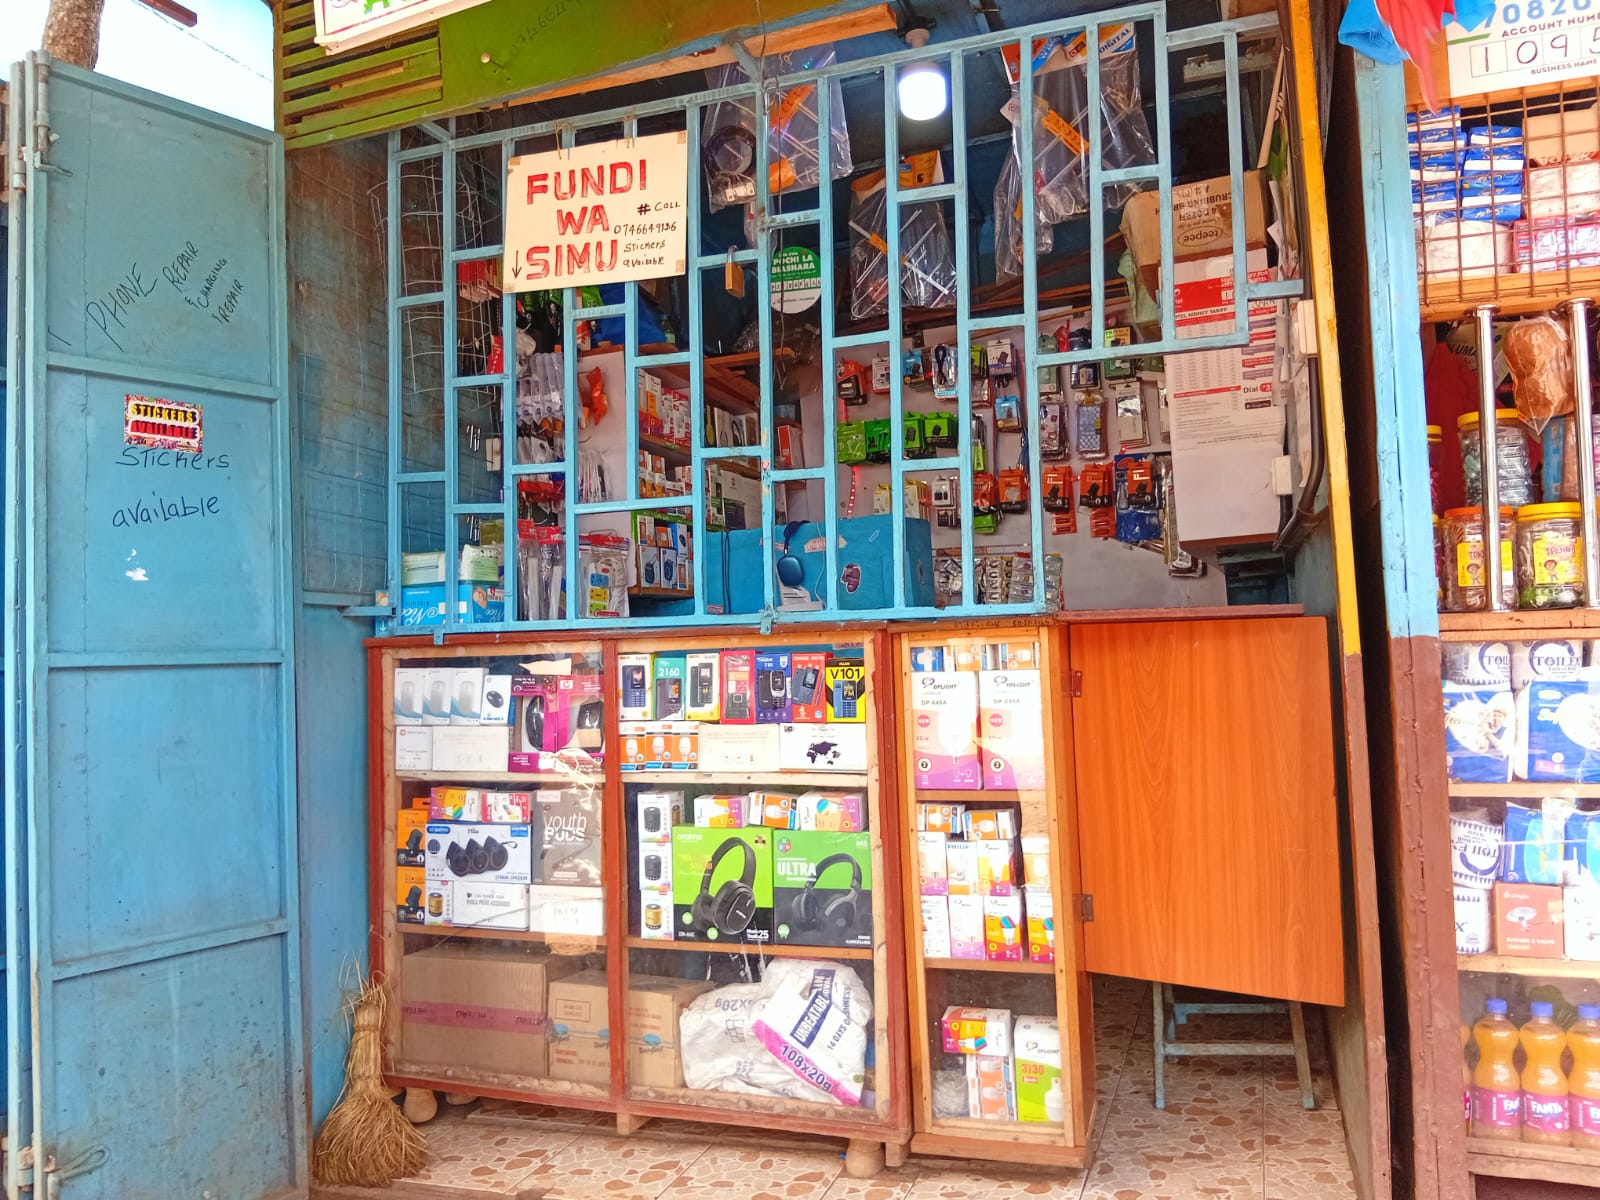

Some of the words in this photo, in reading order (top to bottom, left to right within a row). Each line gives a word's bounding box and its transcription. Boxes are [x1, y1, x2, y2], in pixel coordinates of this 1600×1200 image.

[511, 0, 584, 57] 074664
[1501, 19, 1563, 38] ACCOUNT
[1530, 64, 1572, 75] BUSINESS
[1574, 59, 1598, 68] NAME
[527, 158, 647, 206] FUNDI
[556, 204, 610, 236] WA
[1182, 229, 1218, 243] teepee
[526, 239, 618, 281] SIMU
[802, 254, 814, 262] LA
[199, 257, 228, 309] CHARGING
[86, 261, 158, 352] PHONE
[162, 240, 199, 293] REPAIR
[218, 279, 244, 323] REPAIR
[1243, 385, 1259, 394] Dial
[130, 404, 197, 423] STICKERS
[112, 490, 221, 527] available
[659, 667, 681, 677] 2160
[830, 668, 861, 680] V101
[544, 812, 587, 838] youth
[776, 861, 817, 876] ULTRA
[793, 994, 830, 1043] UNBEATABL
[833, 1024, 848, 1043] DAYS
[781, 1045, 832, 1092] 108x20g
[1531, 1100, 1563, 1115] FANTA
